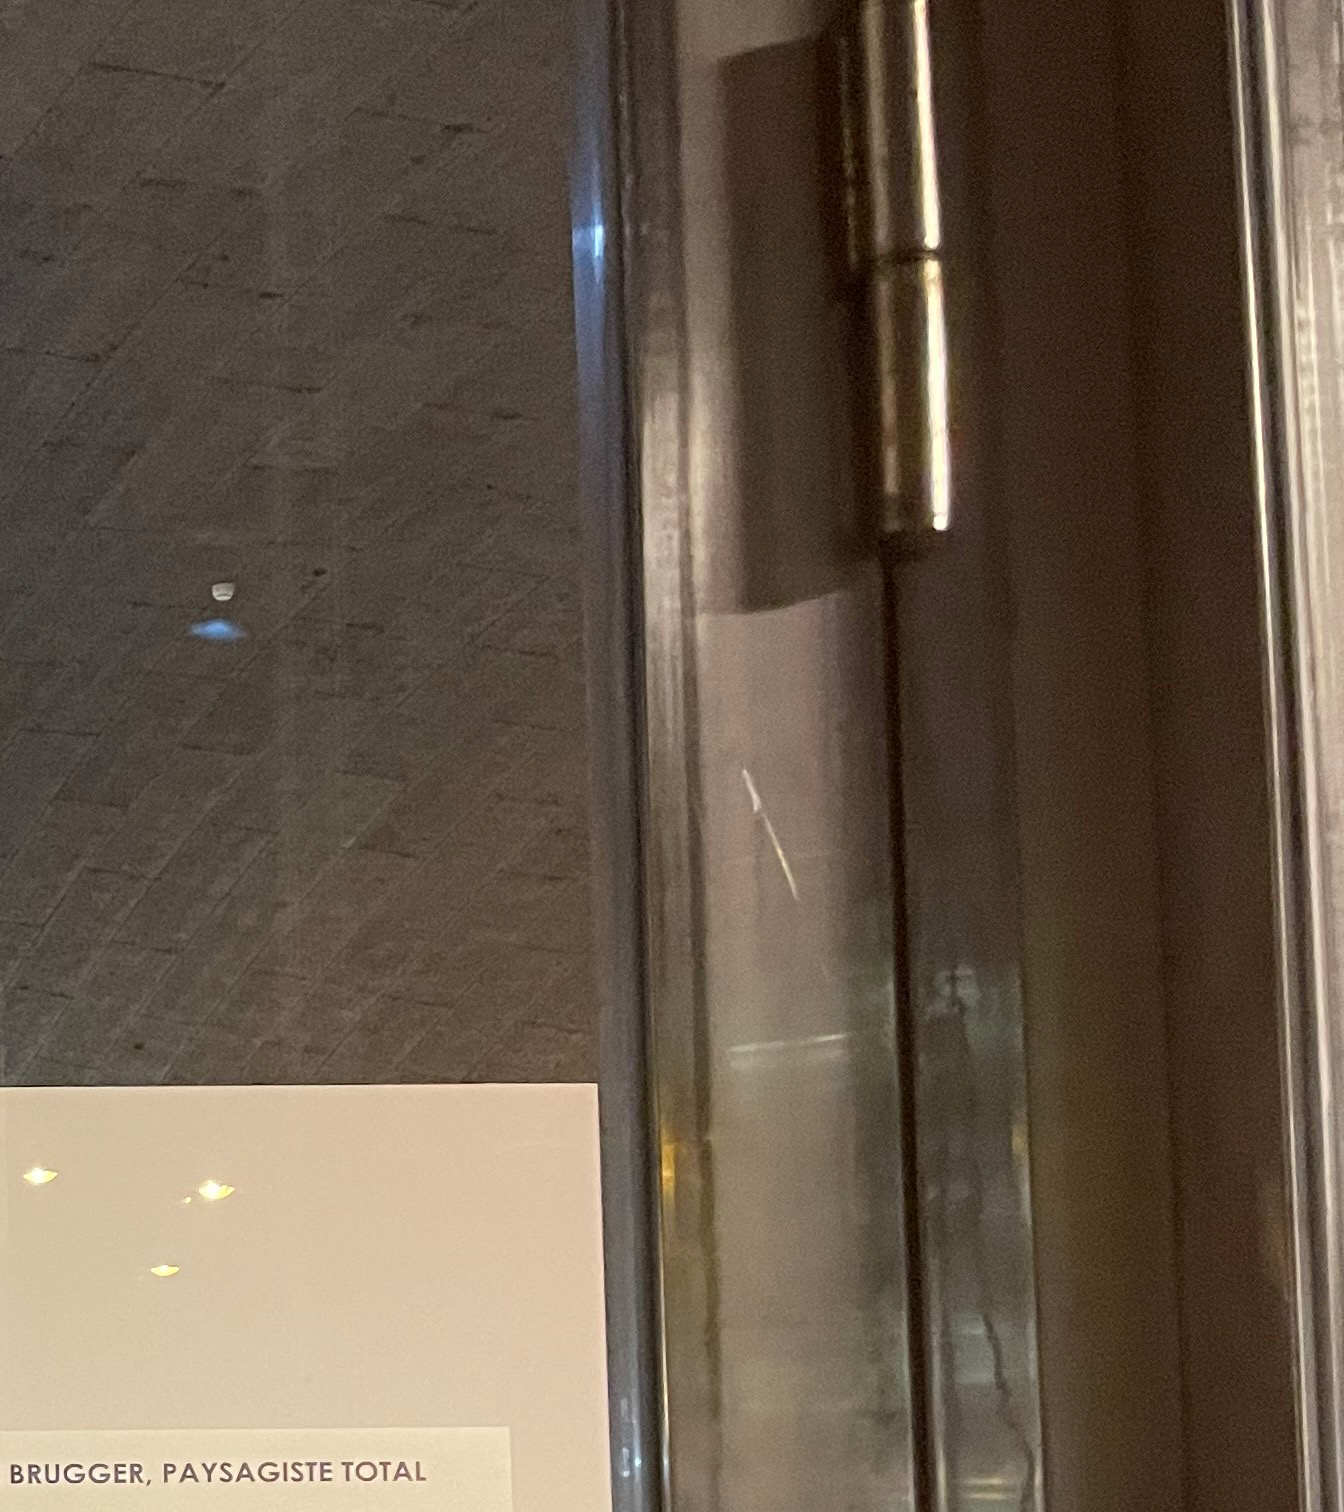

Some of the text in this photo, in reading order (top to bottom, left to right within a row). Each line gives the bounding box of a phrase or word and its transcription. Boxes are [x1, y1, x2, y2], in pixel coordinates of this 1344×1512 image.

[9, 1463, 152, 1488] BRUGGER,
[163, 1462, 333, 1484] PAYSAGISTE
[340, 1461, 427, 1483] TOTAL
